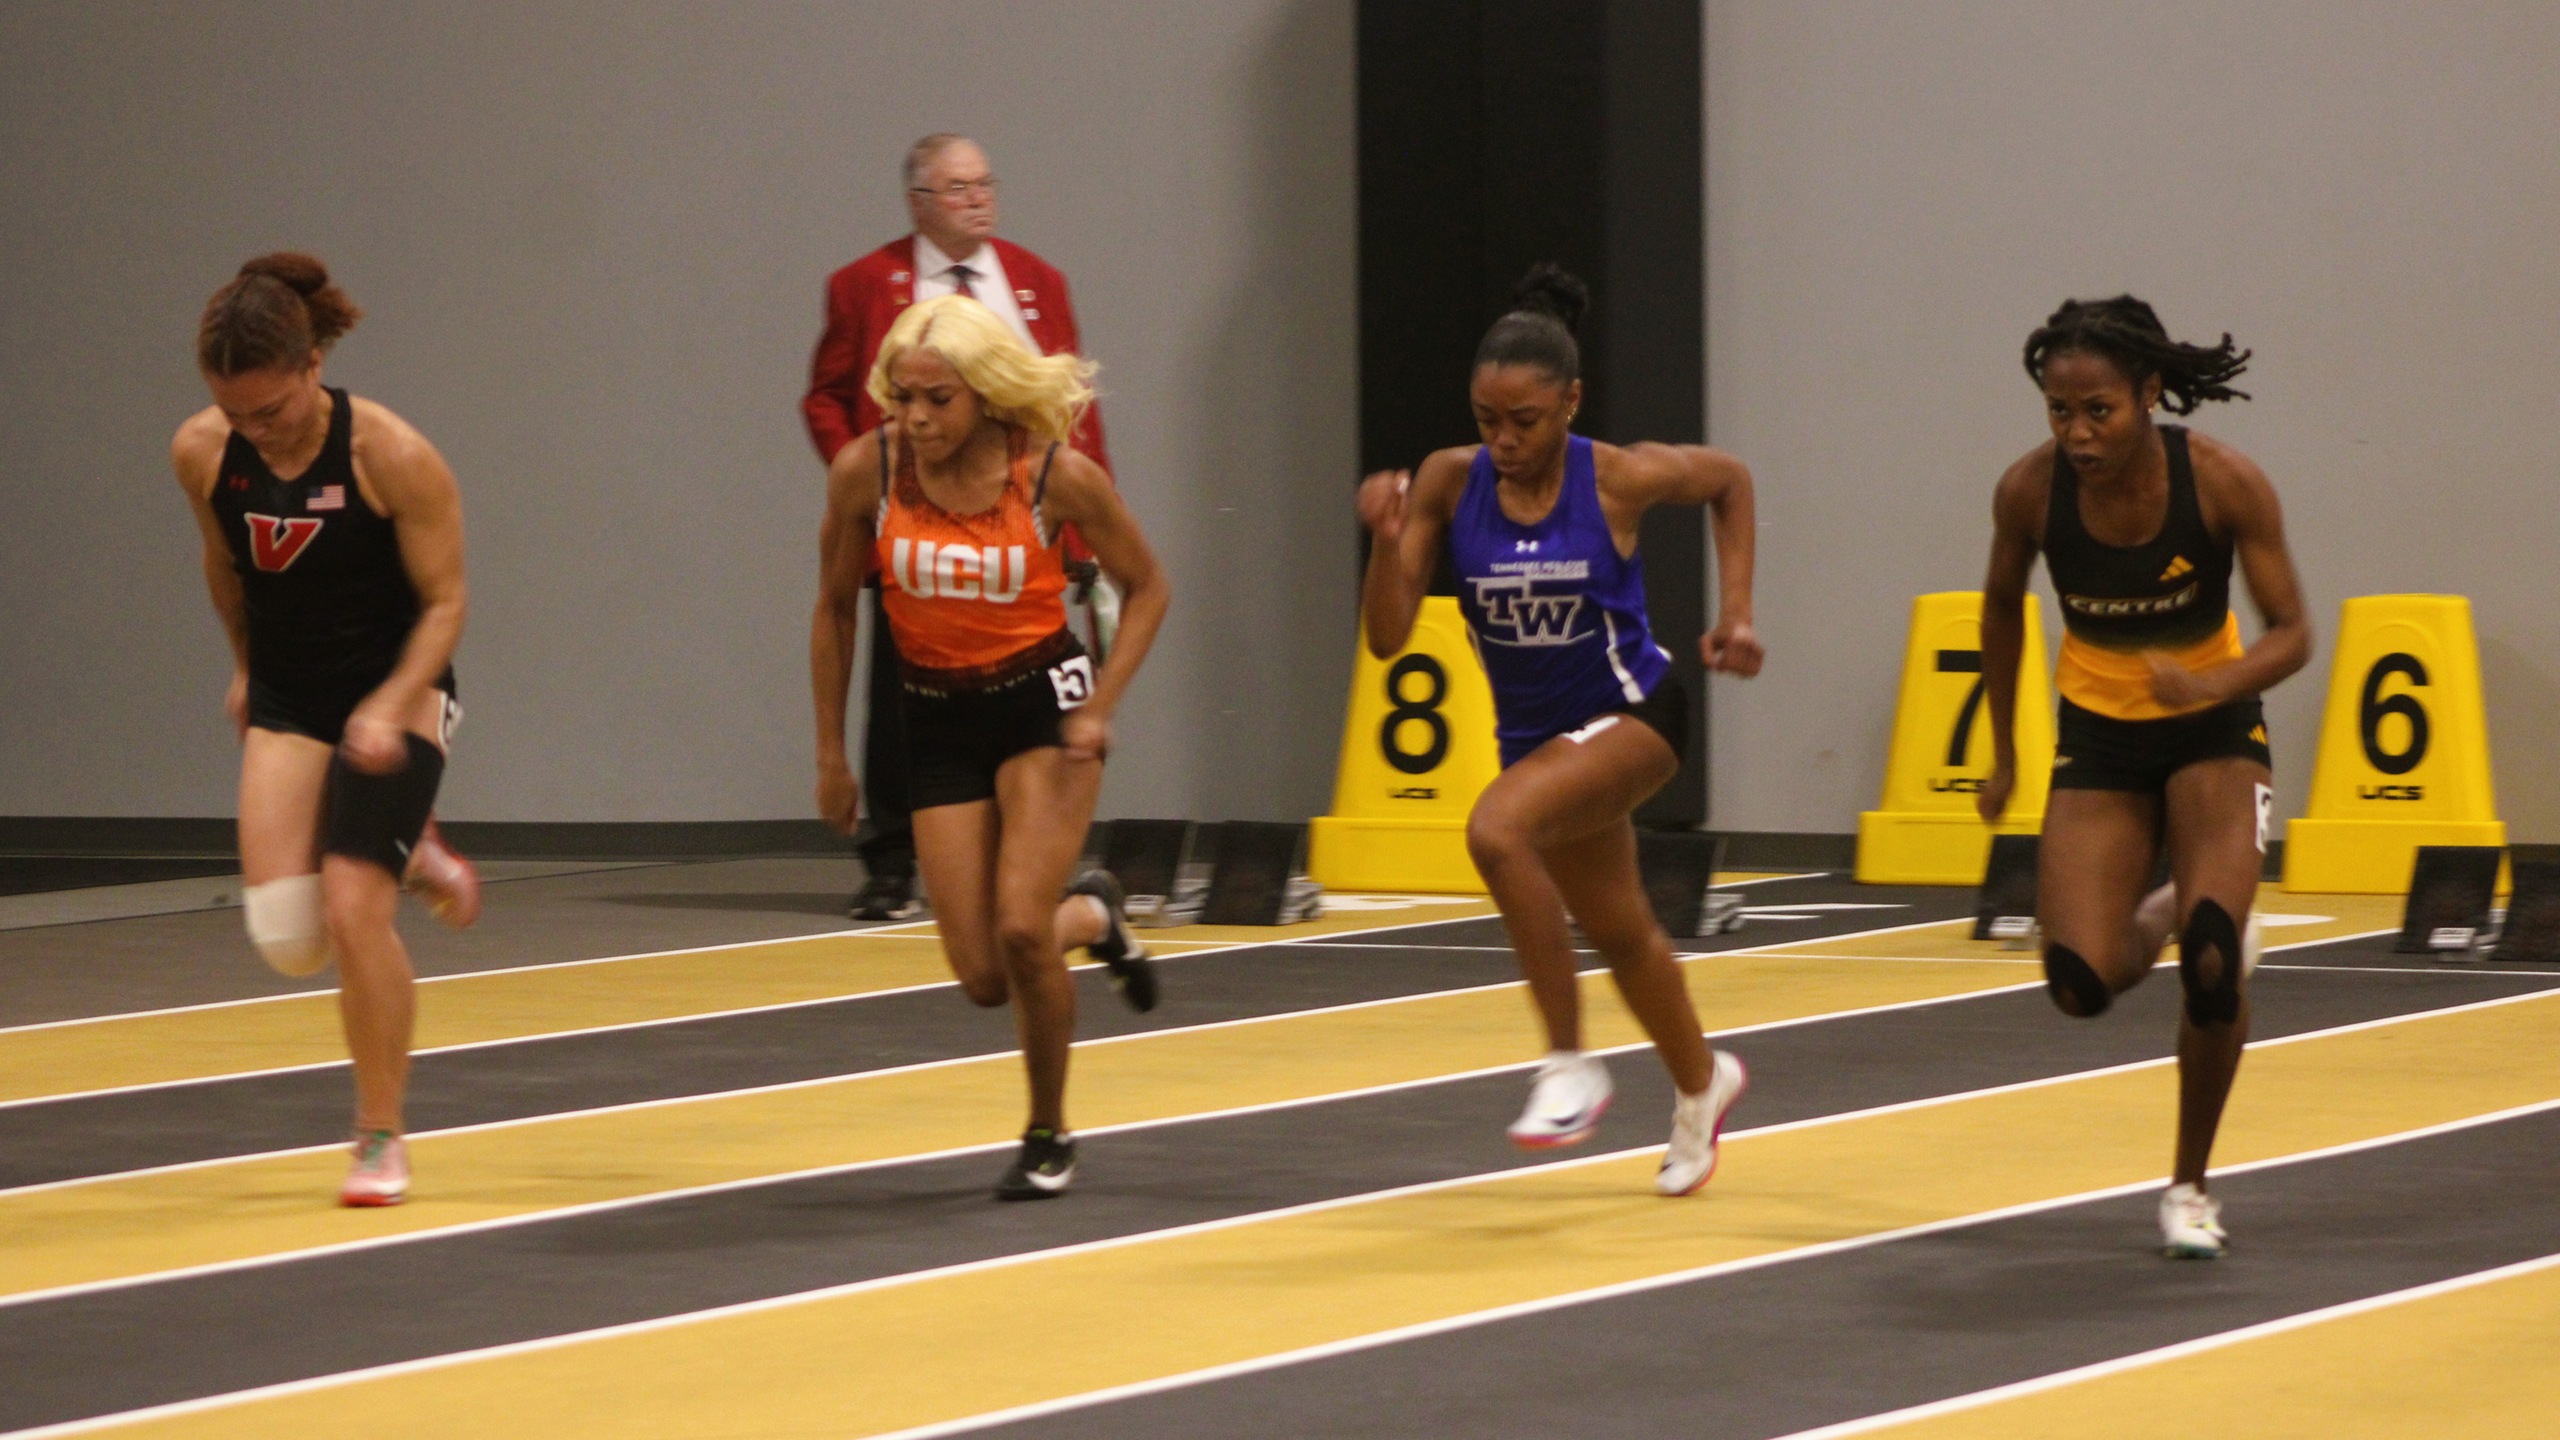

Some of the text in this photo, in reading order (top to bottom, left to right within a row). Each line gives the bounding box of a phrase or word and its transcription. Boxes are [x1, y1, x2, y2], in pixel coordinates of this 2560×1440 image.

[244, 512, 324, 572] V
[892, 537, 1025, 603] UCU
[1478, 581, 1582, 644] TW
[2068, 588, 2193, 615] CENTRE
[1381, 653, 1449, 774] 8
[1935, 650, 1987, 766] 7
[2360, 652, 2430, 775] 6
[2358, 785, 2424, 800] UCS
